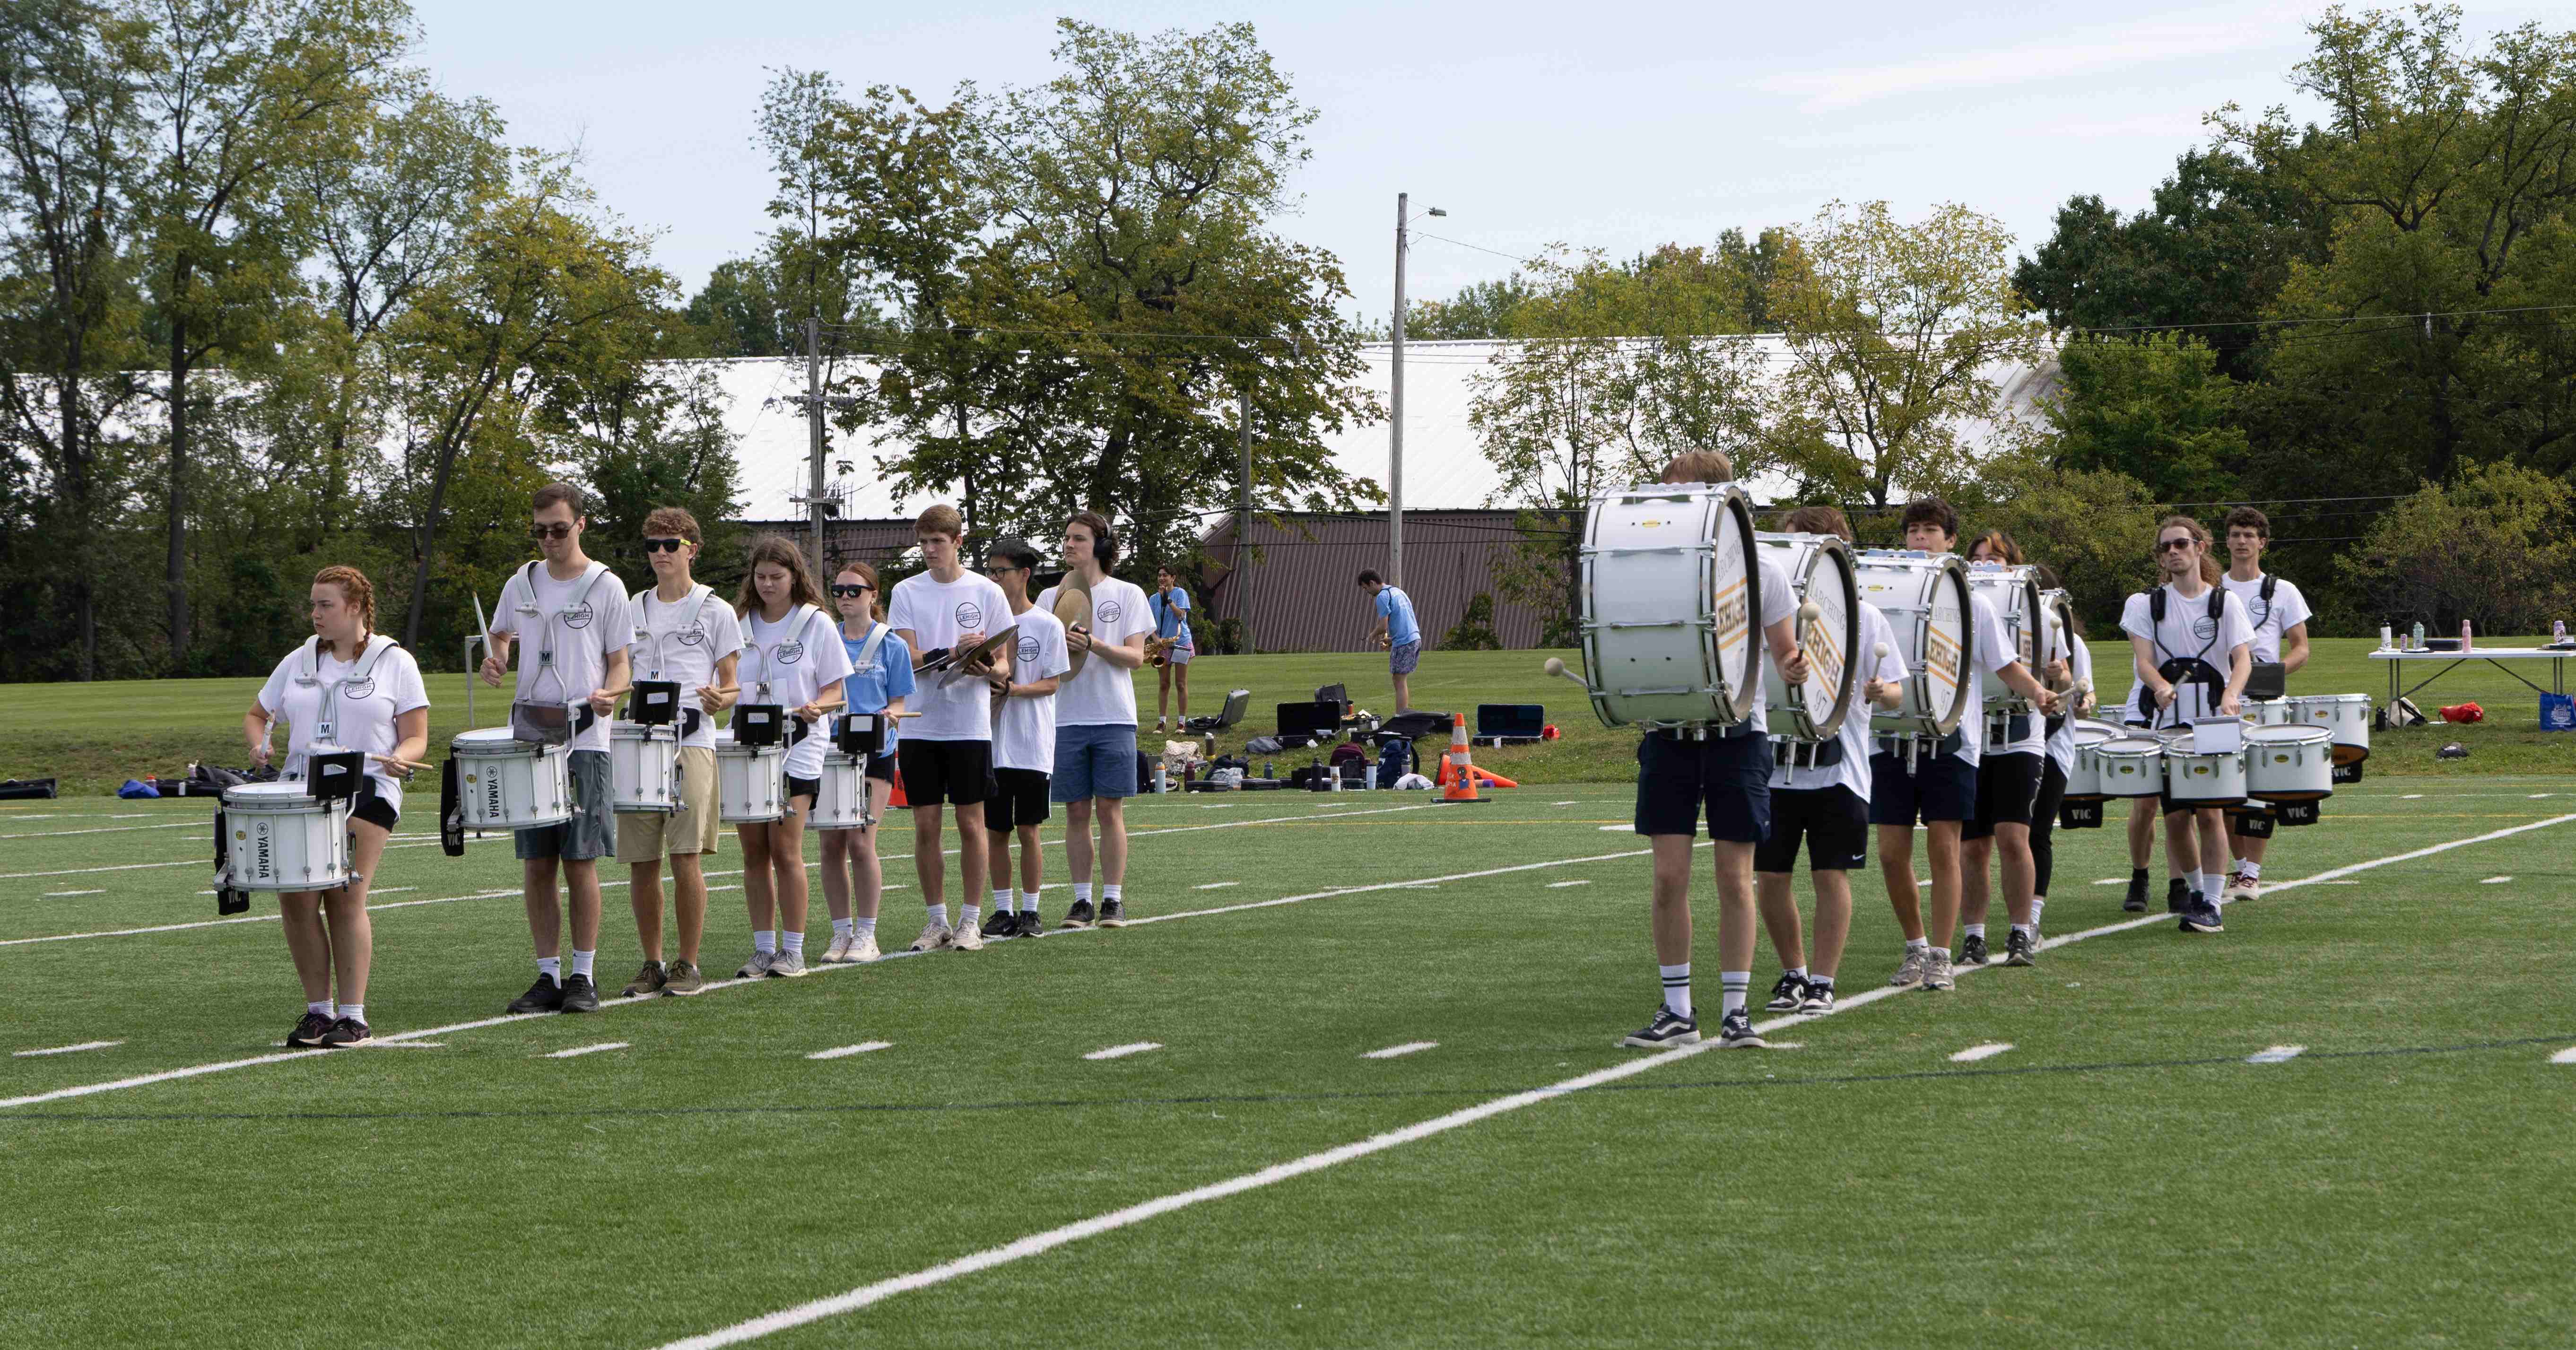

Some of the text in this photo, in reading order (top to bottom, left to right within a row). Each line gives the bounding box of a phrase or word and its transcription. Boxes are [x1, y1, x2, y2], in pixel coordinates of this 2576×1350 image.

[1717, 535, 1742, 584] ARCHING
[1717, 592, 1747, 636] EHIGH
[541, 653, 550, 662] M
[780, 648, 801, 657] LEHIGH
[1807, 621, 1840, 689] EHIGH
[651, 671, 659, 680] M
[759, 684, 767, 692] M
[1814, 688, 1828, 719] 97
[321, 724, 330, 734] M
[2332, 767, 2351, 776] VIC
[488, 779, 499, 818] YAMAHA
[2071, 809, 2091, 820] VIC
[2287, 806, 2308, 819] VIC
[2249, 819, 2266, 830] VIC
[447, 833, 461, 846] VIC
[258, 836, 270, 879] YAMAHA
